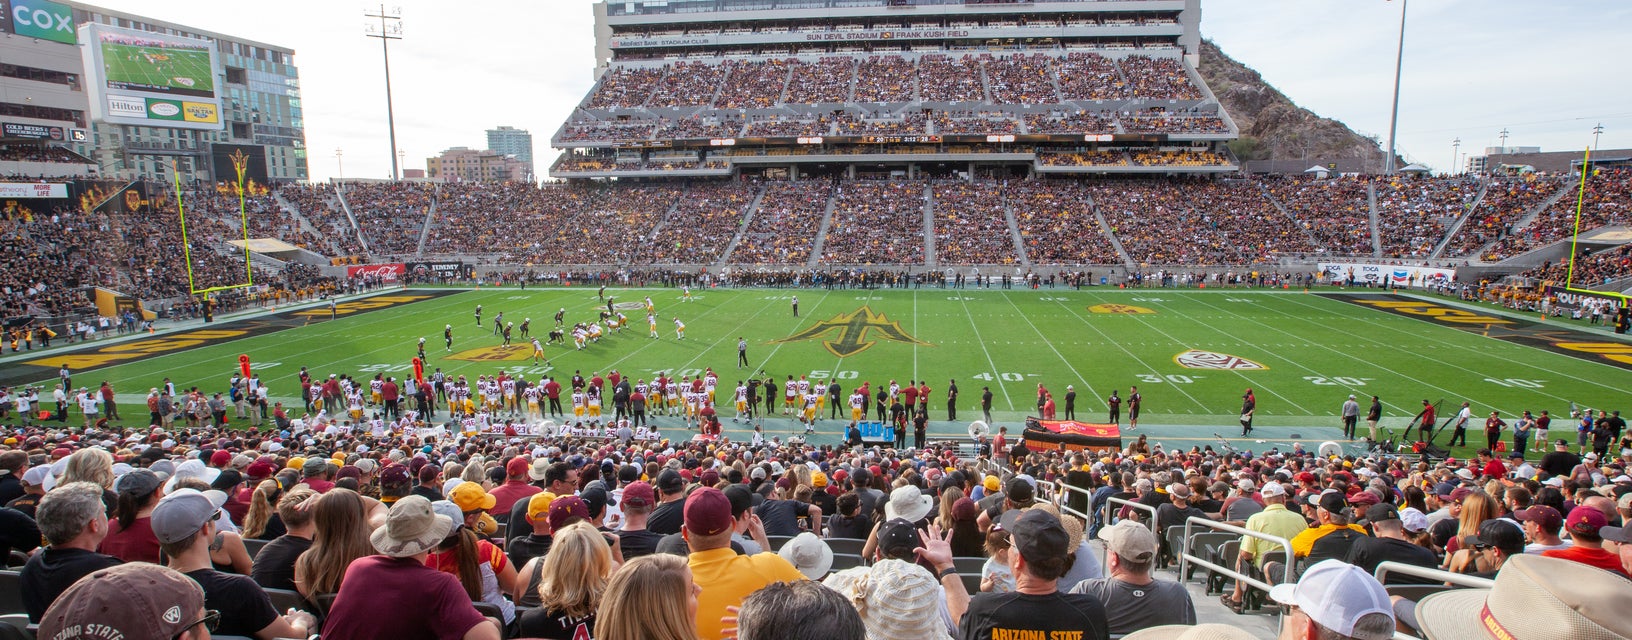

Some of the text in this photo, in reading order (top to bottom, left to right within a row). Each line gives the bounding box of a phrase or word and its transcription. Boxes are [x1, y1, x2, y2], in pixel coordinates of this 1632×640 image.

[13, 5, 74, 34] COX
[112, 102, 144, 111] Hilton
[504, 366, 554, 374] 30
[808, 370, 859, 379] 50
[972, 372, 1024, 382] 40
[1136, 374, 1194, 384] 30
[1302, 376, 1370, 386] 20
[992, 628, 1046, 640] ARIZONA
